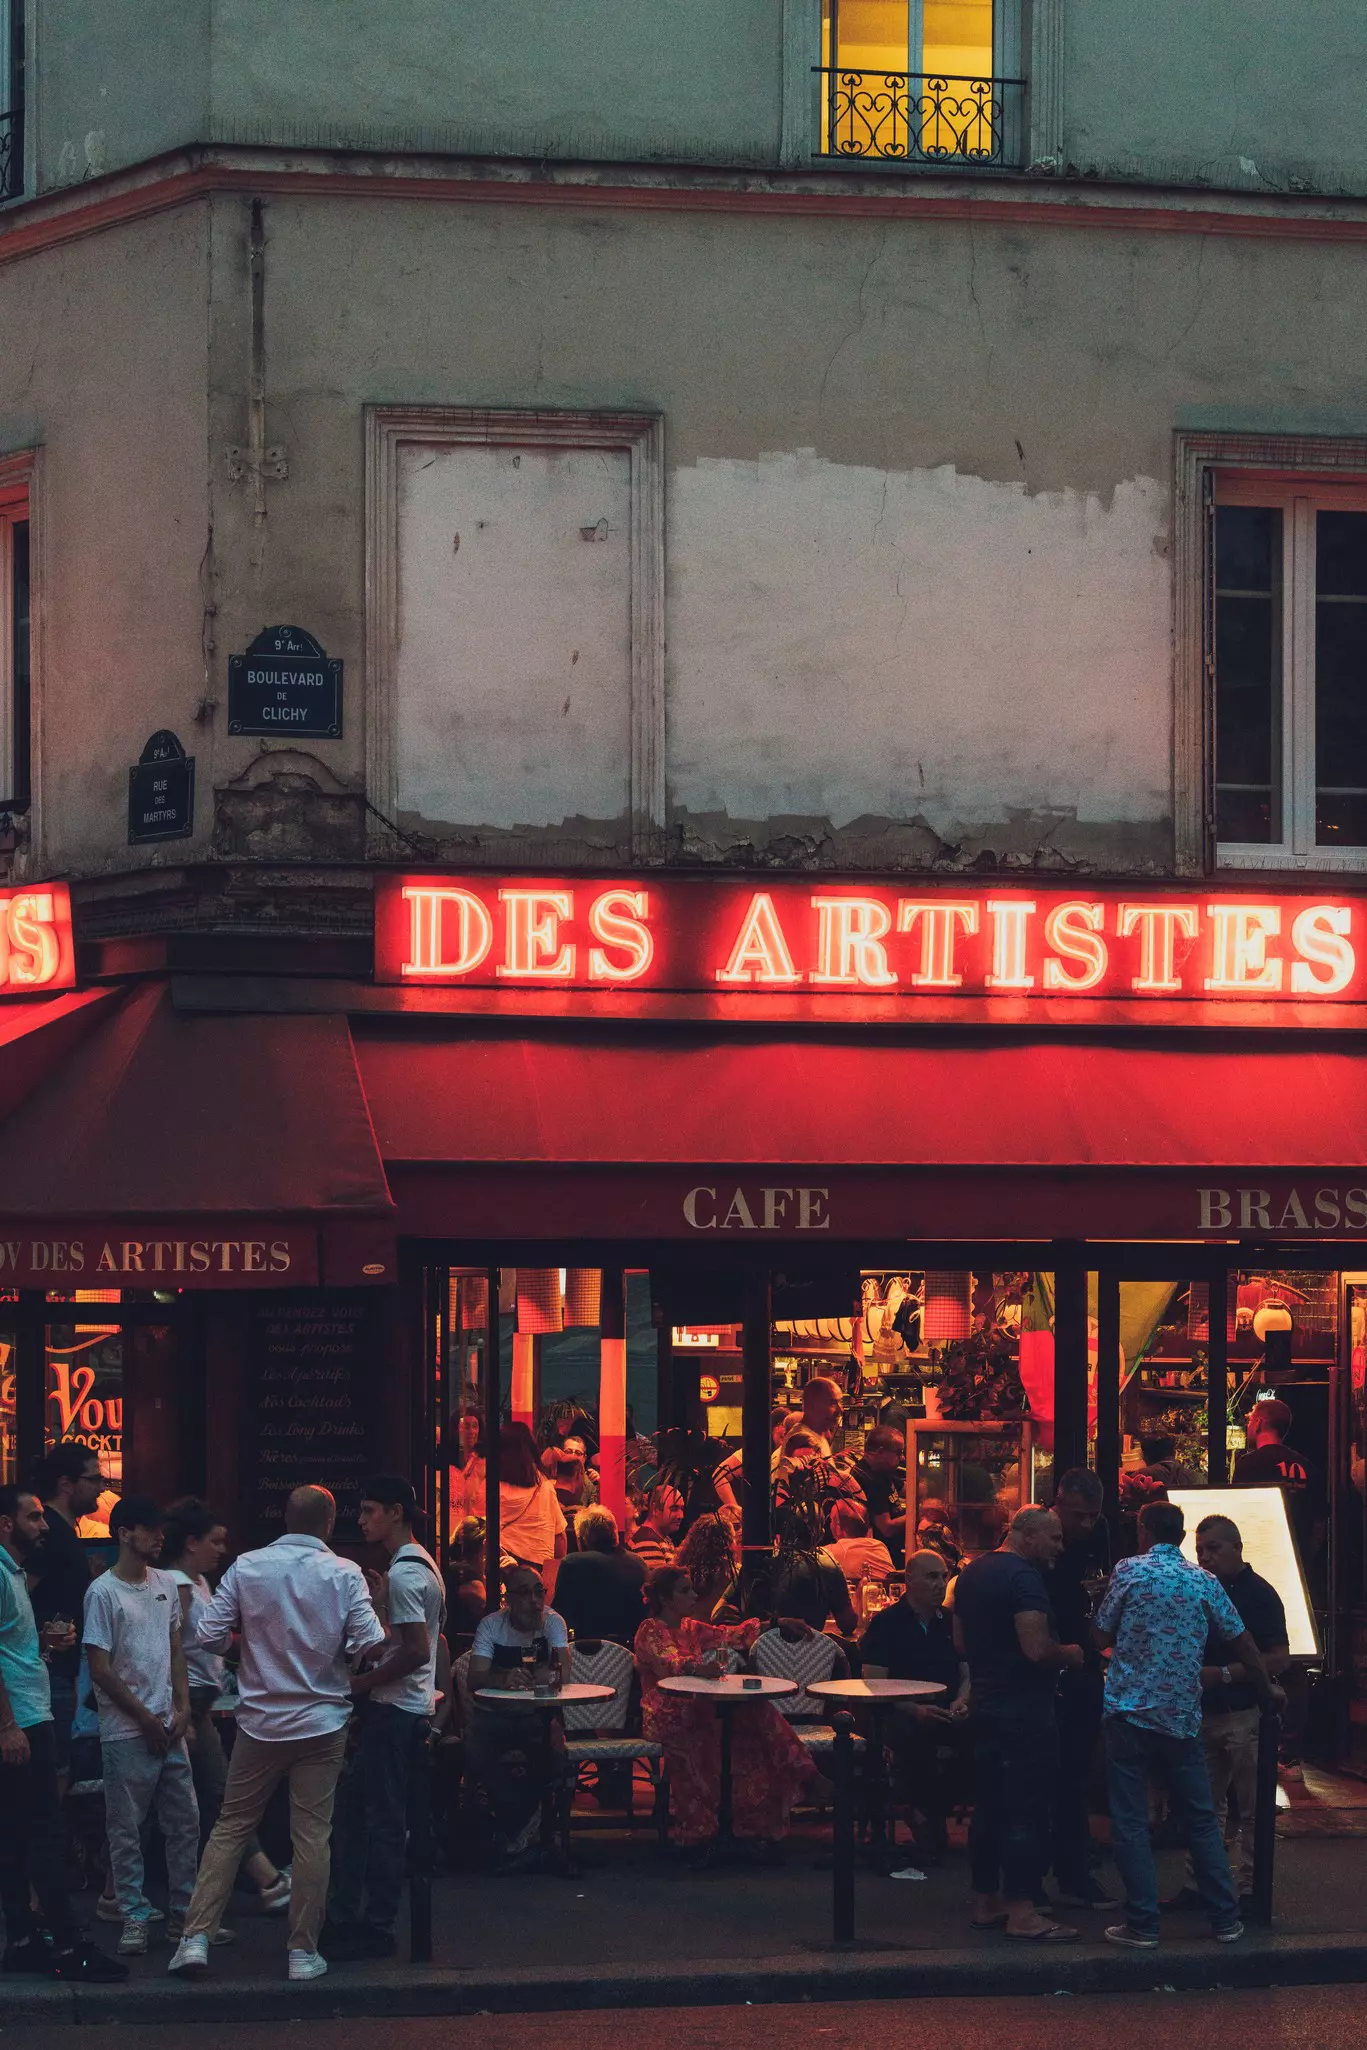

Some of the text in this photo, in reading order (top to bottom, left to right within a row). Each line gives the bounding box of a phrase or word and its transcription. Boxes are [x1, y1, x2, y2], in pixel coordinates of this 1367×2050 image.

[247, 670, 324, 687] BOULEVARD
[277, 692, 287, 700] DE
[262, 707, 308, 721] CLICHY
[153, 780, 168, 792] RUE
[154, 795, 166, 805] DES
[143, 809, 177, 824] MARTYRS
[401, 886, 1356, 994] DES ARTISTES
[682, 1187, 1367, 1231] CAFE BRASS
[30, 1241, 84, 1272] DES
[96, 1241, 291, 1272] ARTISTES
